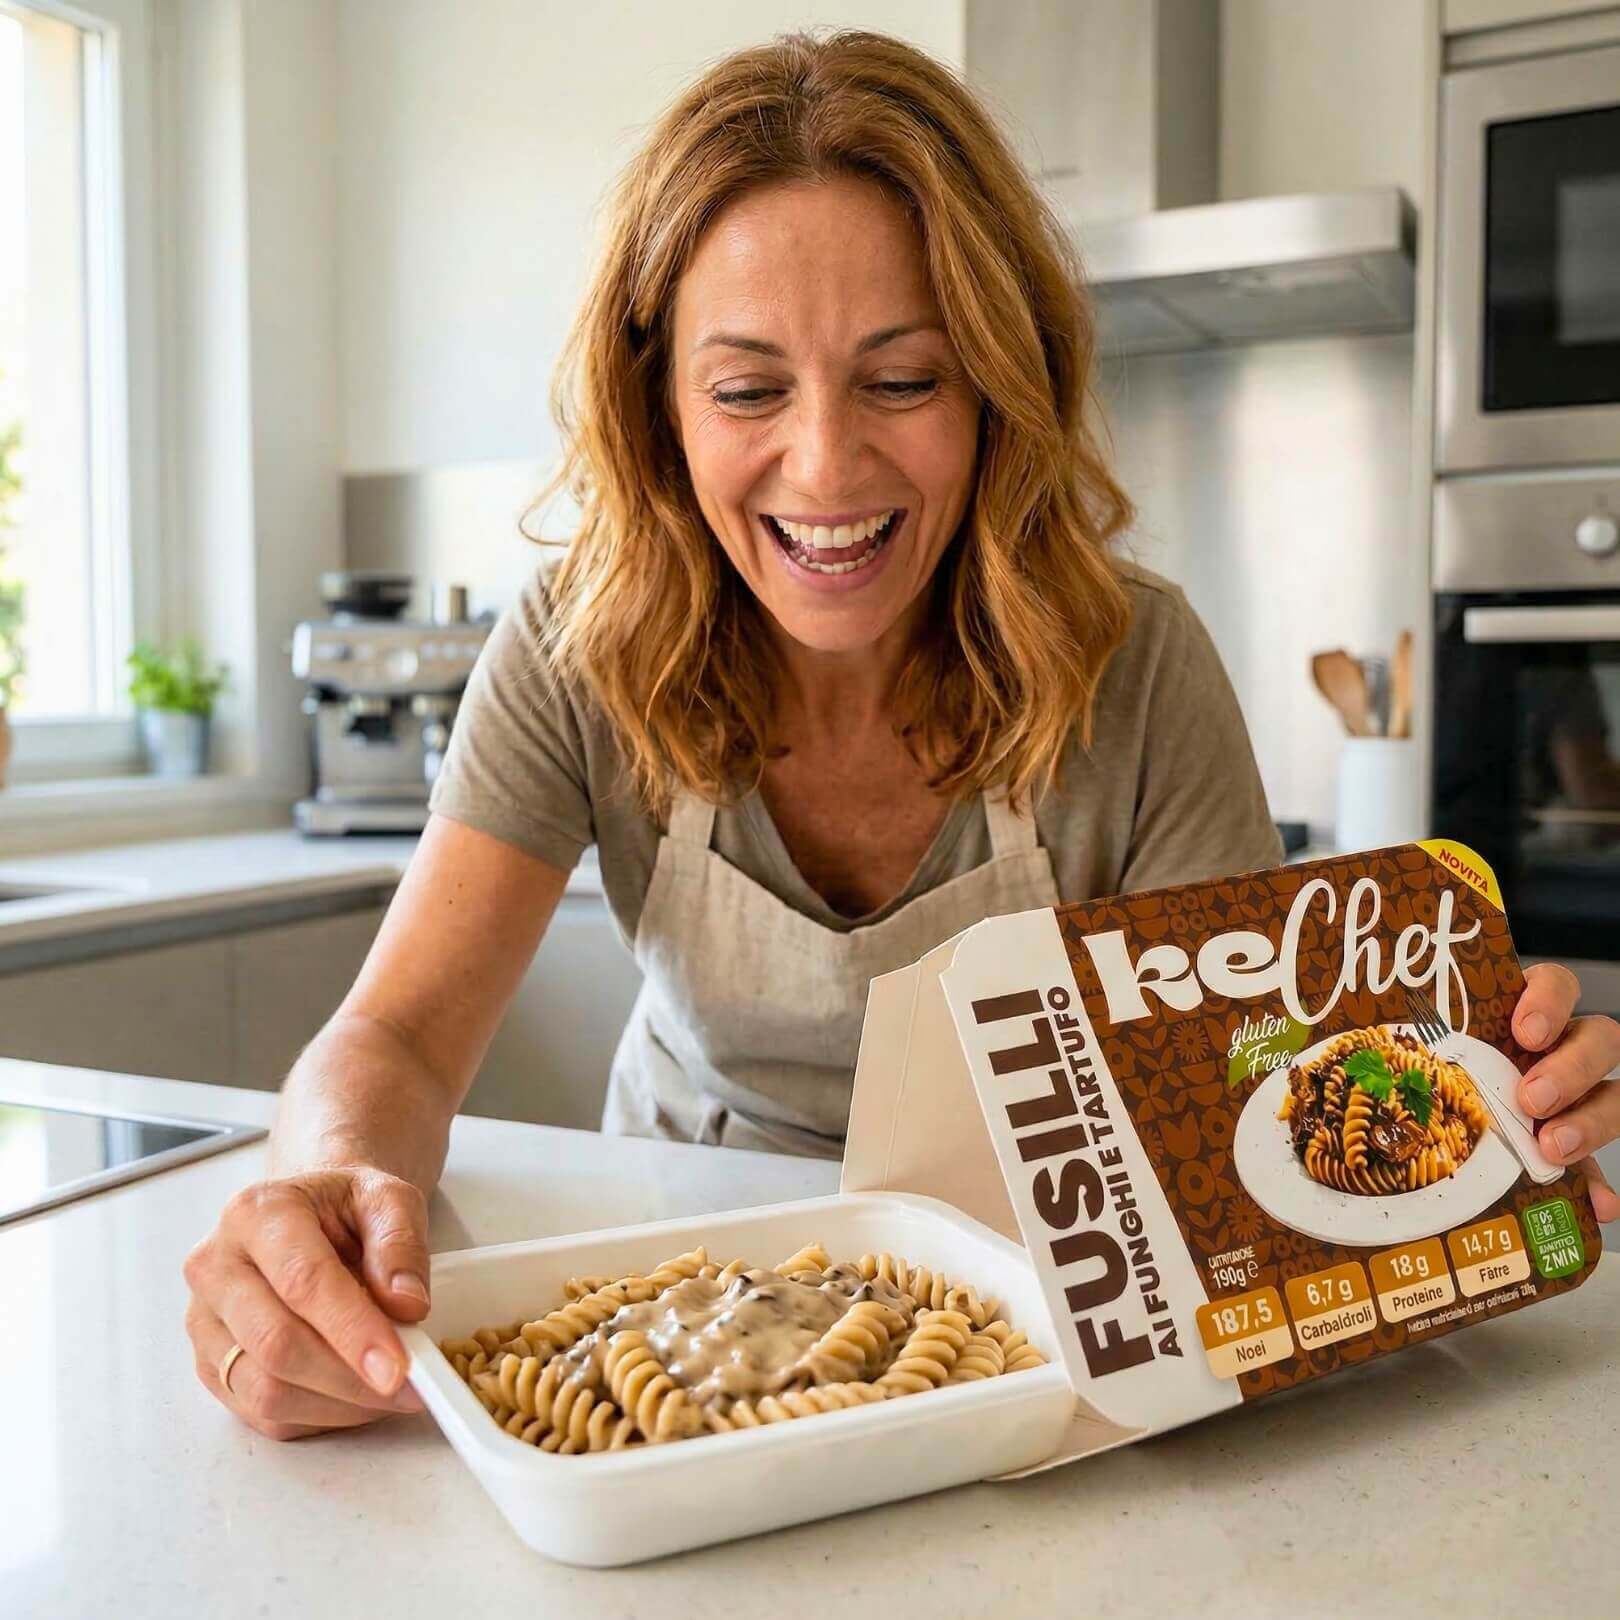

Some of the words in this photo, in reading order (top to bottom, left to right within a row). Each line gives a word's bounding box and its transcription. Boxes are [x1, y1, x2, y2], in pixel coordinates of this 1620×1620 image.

[1227, 1011, 1291, 1059] gluten
[1047, 985, 1114, 1146] TARTUFO
[1245, 1041, 1294, 1081] Free
[1101, 1145, 1123, 1169] E
[971, 988, 1156, 1379] FUSILLI
[1106, 1171, 1169, 1316] FUNGHI
[1461, 1229, 1495, 1257] 14,7
[1500, 1229, 1512, 1251] g
[1212, 1265, 1247, 1289] 190g
[1390, 1254, 1414, 1280] 18
[1416, 1255, 1430, 1277] g
[1306, 1278, 1334, 1307] 6,7
[1338, 1279, 1354, 1302] g
[1392, 1285, 1444, 1312] Proteine
[1211, 1298, 1273, 1337] 187,5
[1154, 1317, 1184, 1358] AI
